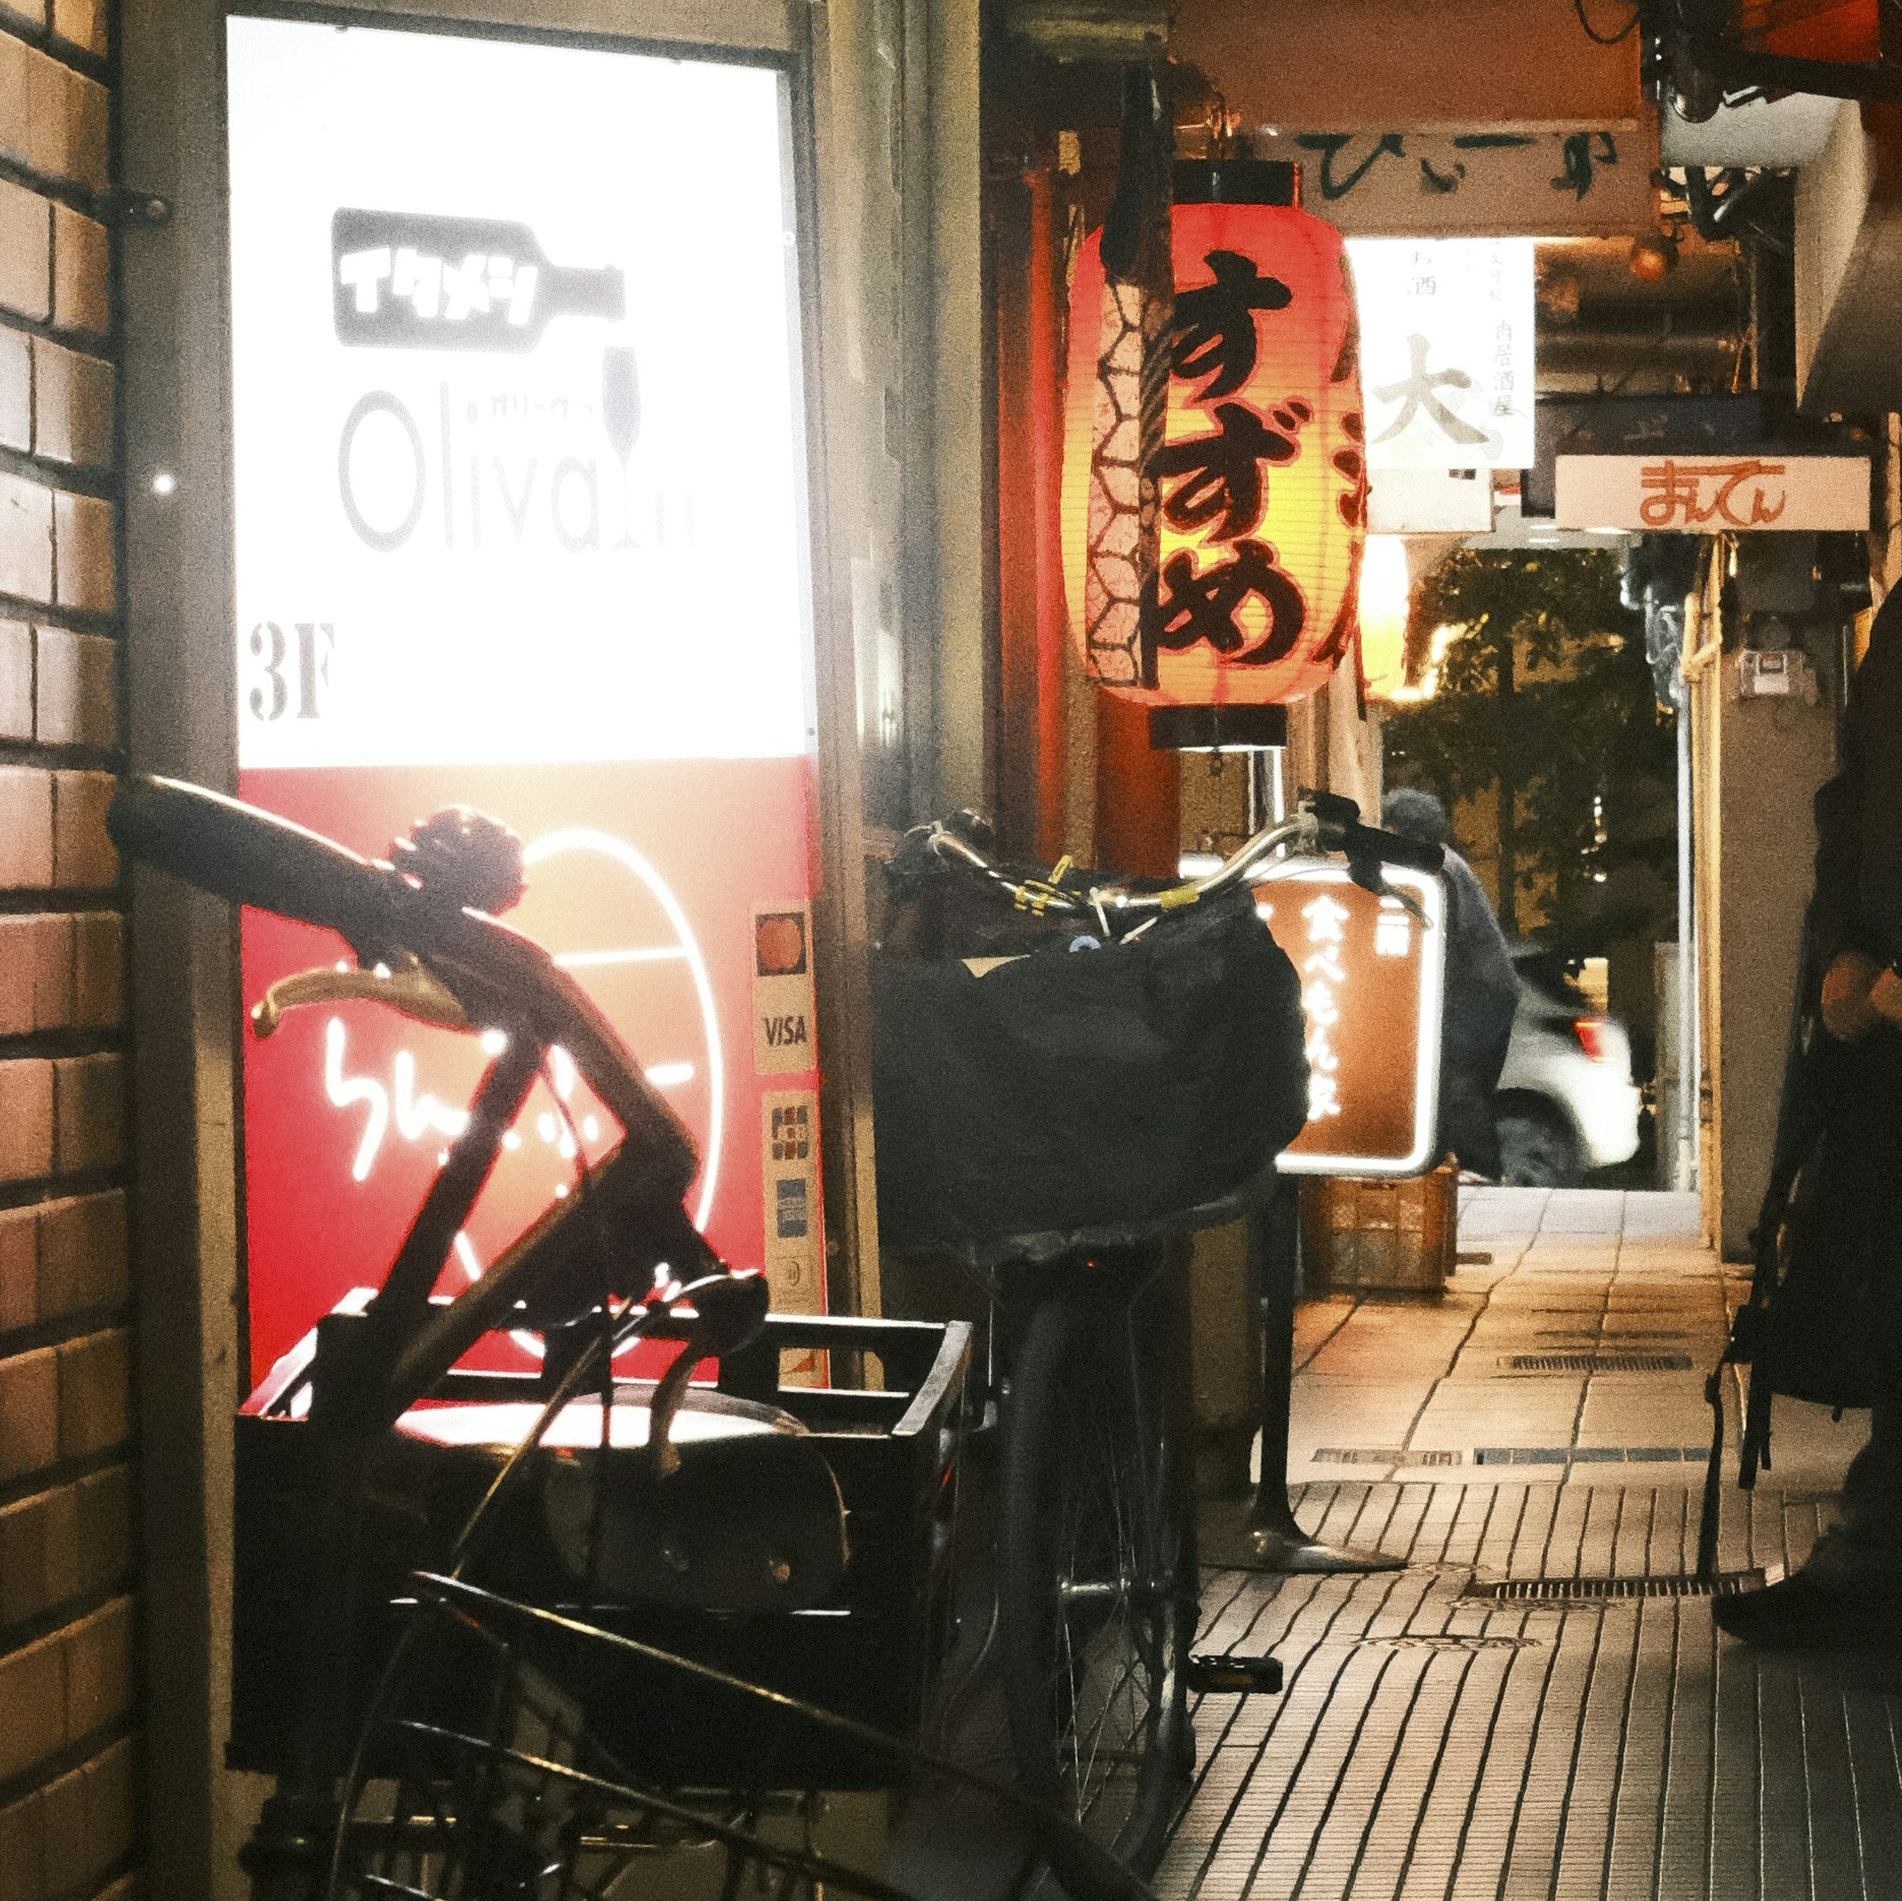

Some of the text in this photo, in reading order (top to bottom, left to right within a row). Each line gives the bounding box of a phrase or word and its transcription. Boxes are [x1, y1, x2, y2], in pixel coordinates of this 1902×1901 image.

[1146, 250, 1310, 665] すずめ
[1639, 459, 1787, 526] まんてん
[248, 620, 334, 722] 3F
[763, 1014, 808, 1047] VISA
